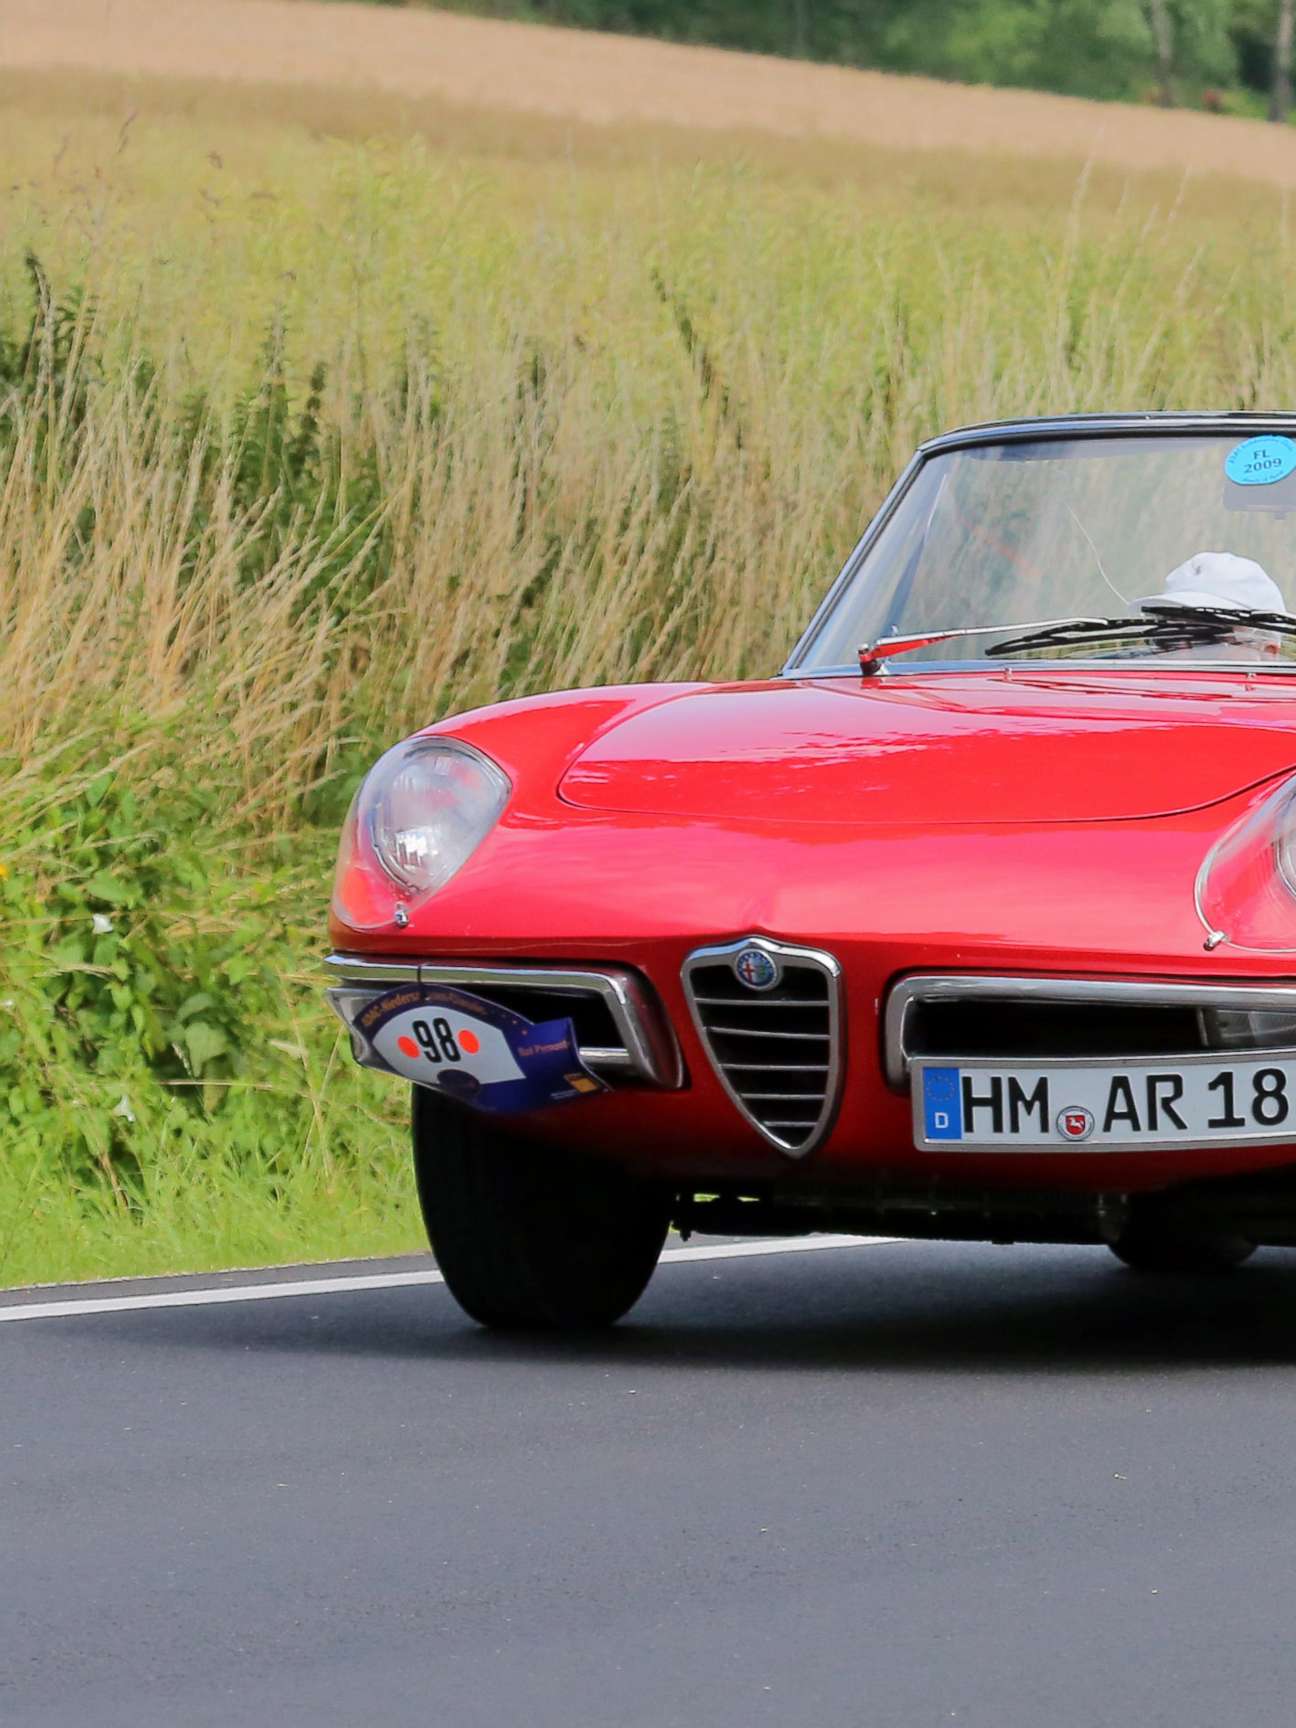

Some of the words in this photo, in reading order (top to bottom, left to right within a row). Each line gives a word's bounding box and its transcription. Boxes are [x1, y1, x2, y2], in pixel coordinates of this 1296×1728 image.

[1253, 449, 1270, 460] FL
[1243, 457, 1283, 474] 2009
[412, 1017, 461, 1063] 98
[961, 1075, 1050, 1133] HM
[1102, 1073, 1188, 1133] AR
[934, 1112, 949, 1129] D
